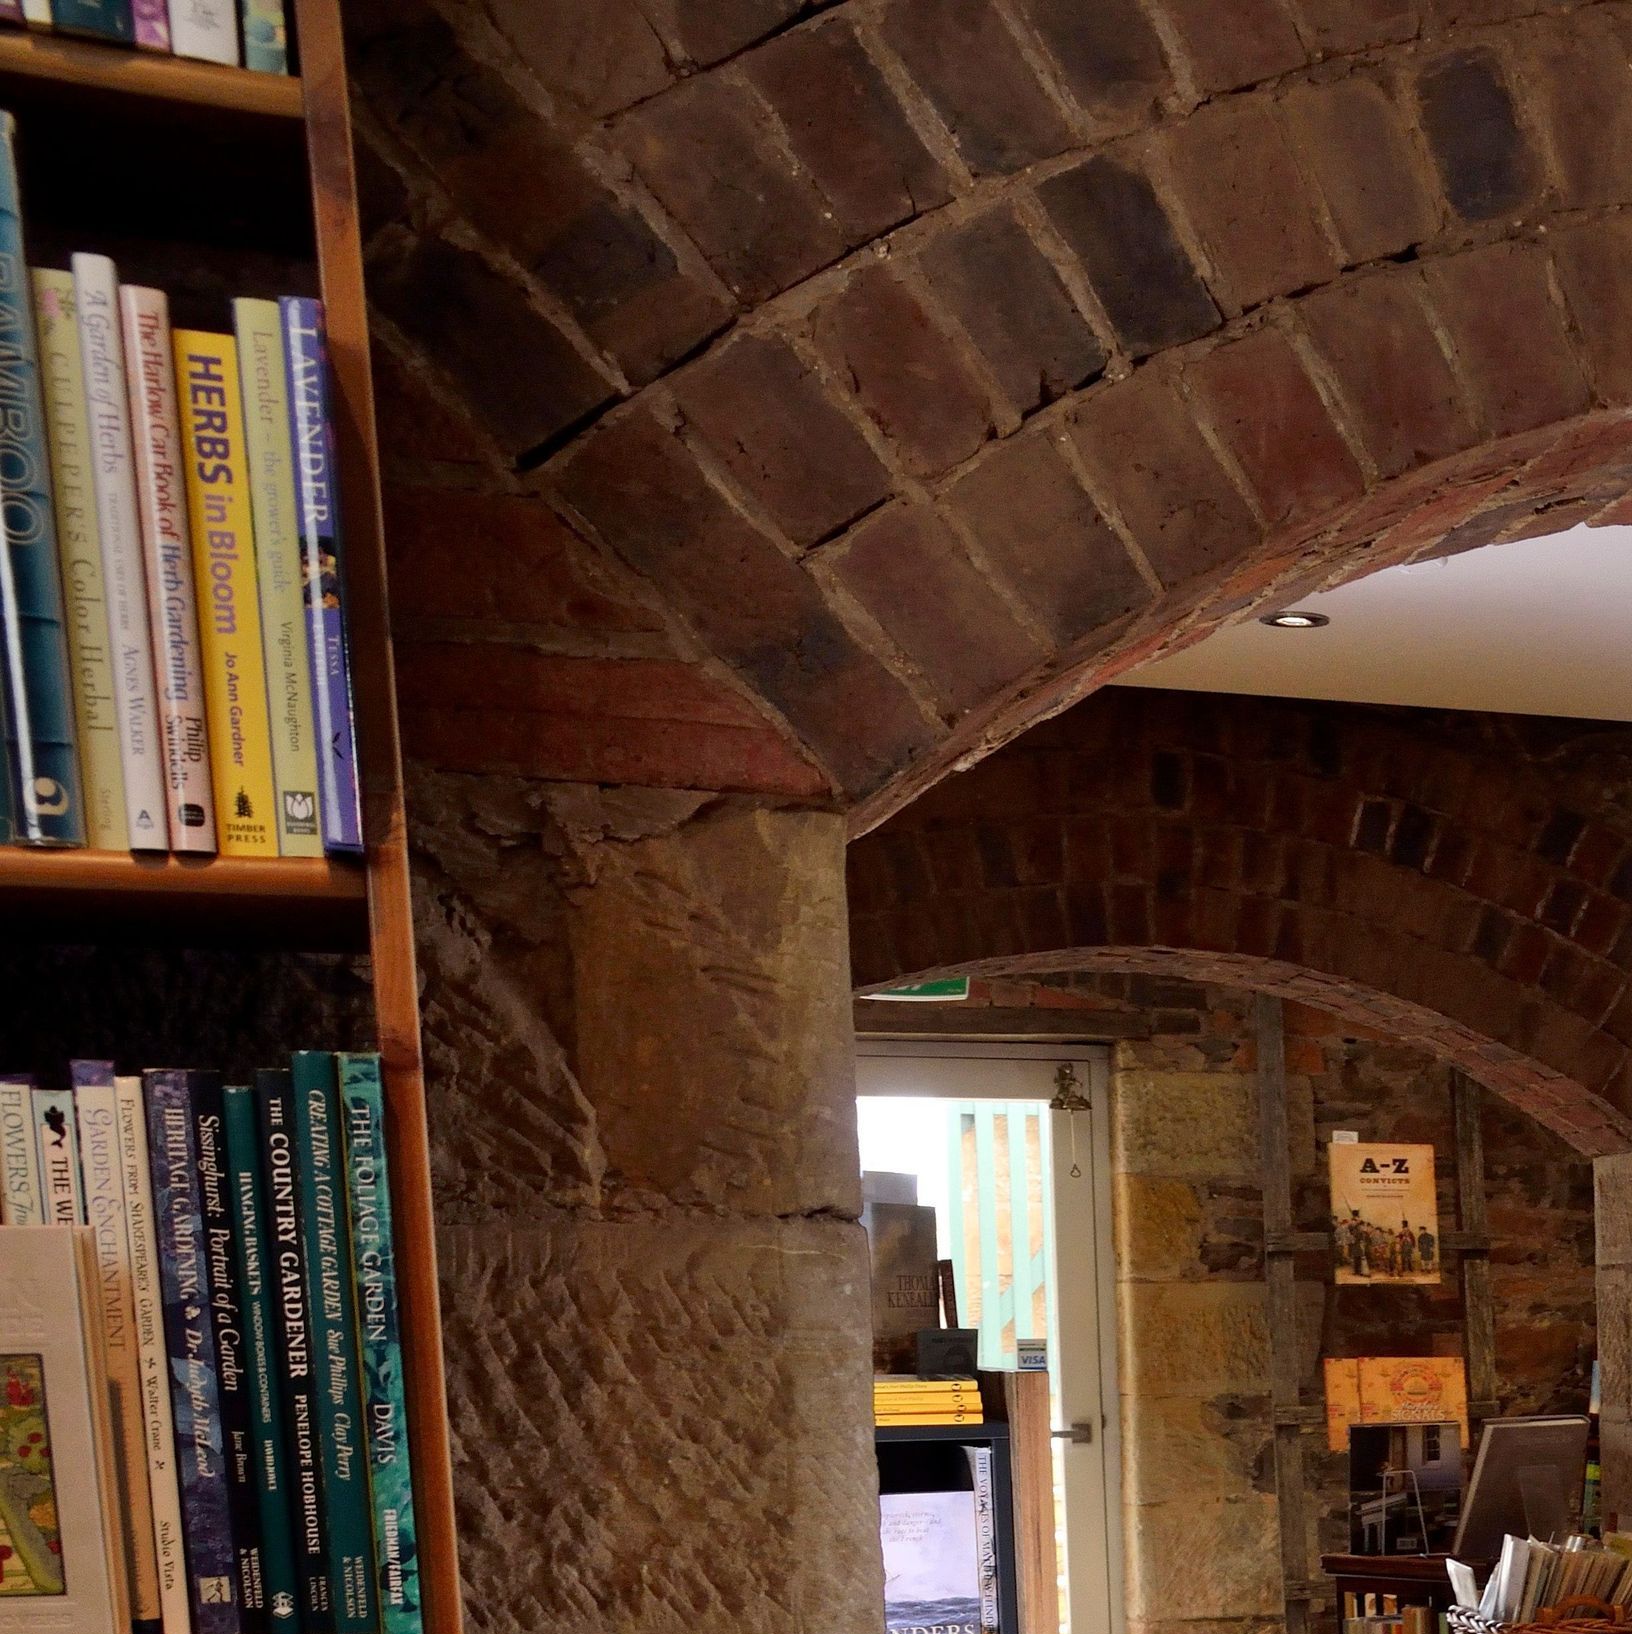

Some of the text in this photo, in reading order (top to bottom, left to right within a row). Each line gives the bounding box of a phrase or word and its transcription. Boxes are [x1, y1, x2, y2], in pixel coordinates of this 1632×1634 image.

[188, 354, 240, 634] HERBS in Bloom
[291, 328, 329, 523] LAVENDER
[137, 311, 192, 701] The Harlow Car Book of Herb Gardening
[225, 652, 247, 767] Jo Ann Gardner
[280, 622, 303, 752] Virginia McNaughton
[1, 1090, 31, 1192] FLOWERS
[163, 1109, 200, 1299] HERITAGE GARDENING
[1360, 1158, 1409, 1173] A-Z
[270, 1098, 308, 1378] THE COUNTRY GARDENER
[351, 1105, 387, 1341] THE FOLIAGE GARDEN
[374, 1404, 394, 1464] DAVIS
[1022, 1355, 1046, 1364] VISA
[295, 1395, 320, 1554] PENELOPE HOBHOUSE
